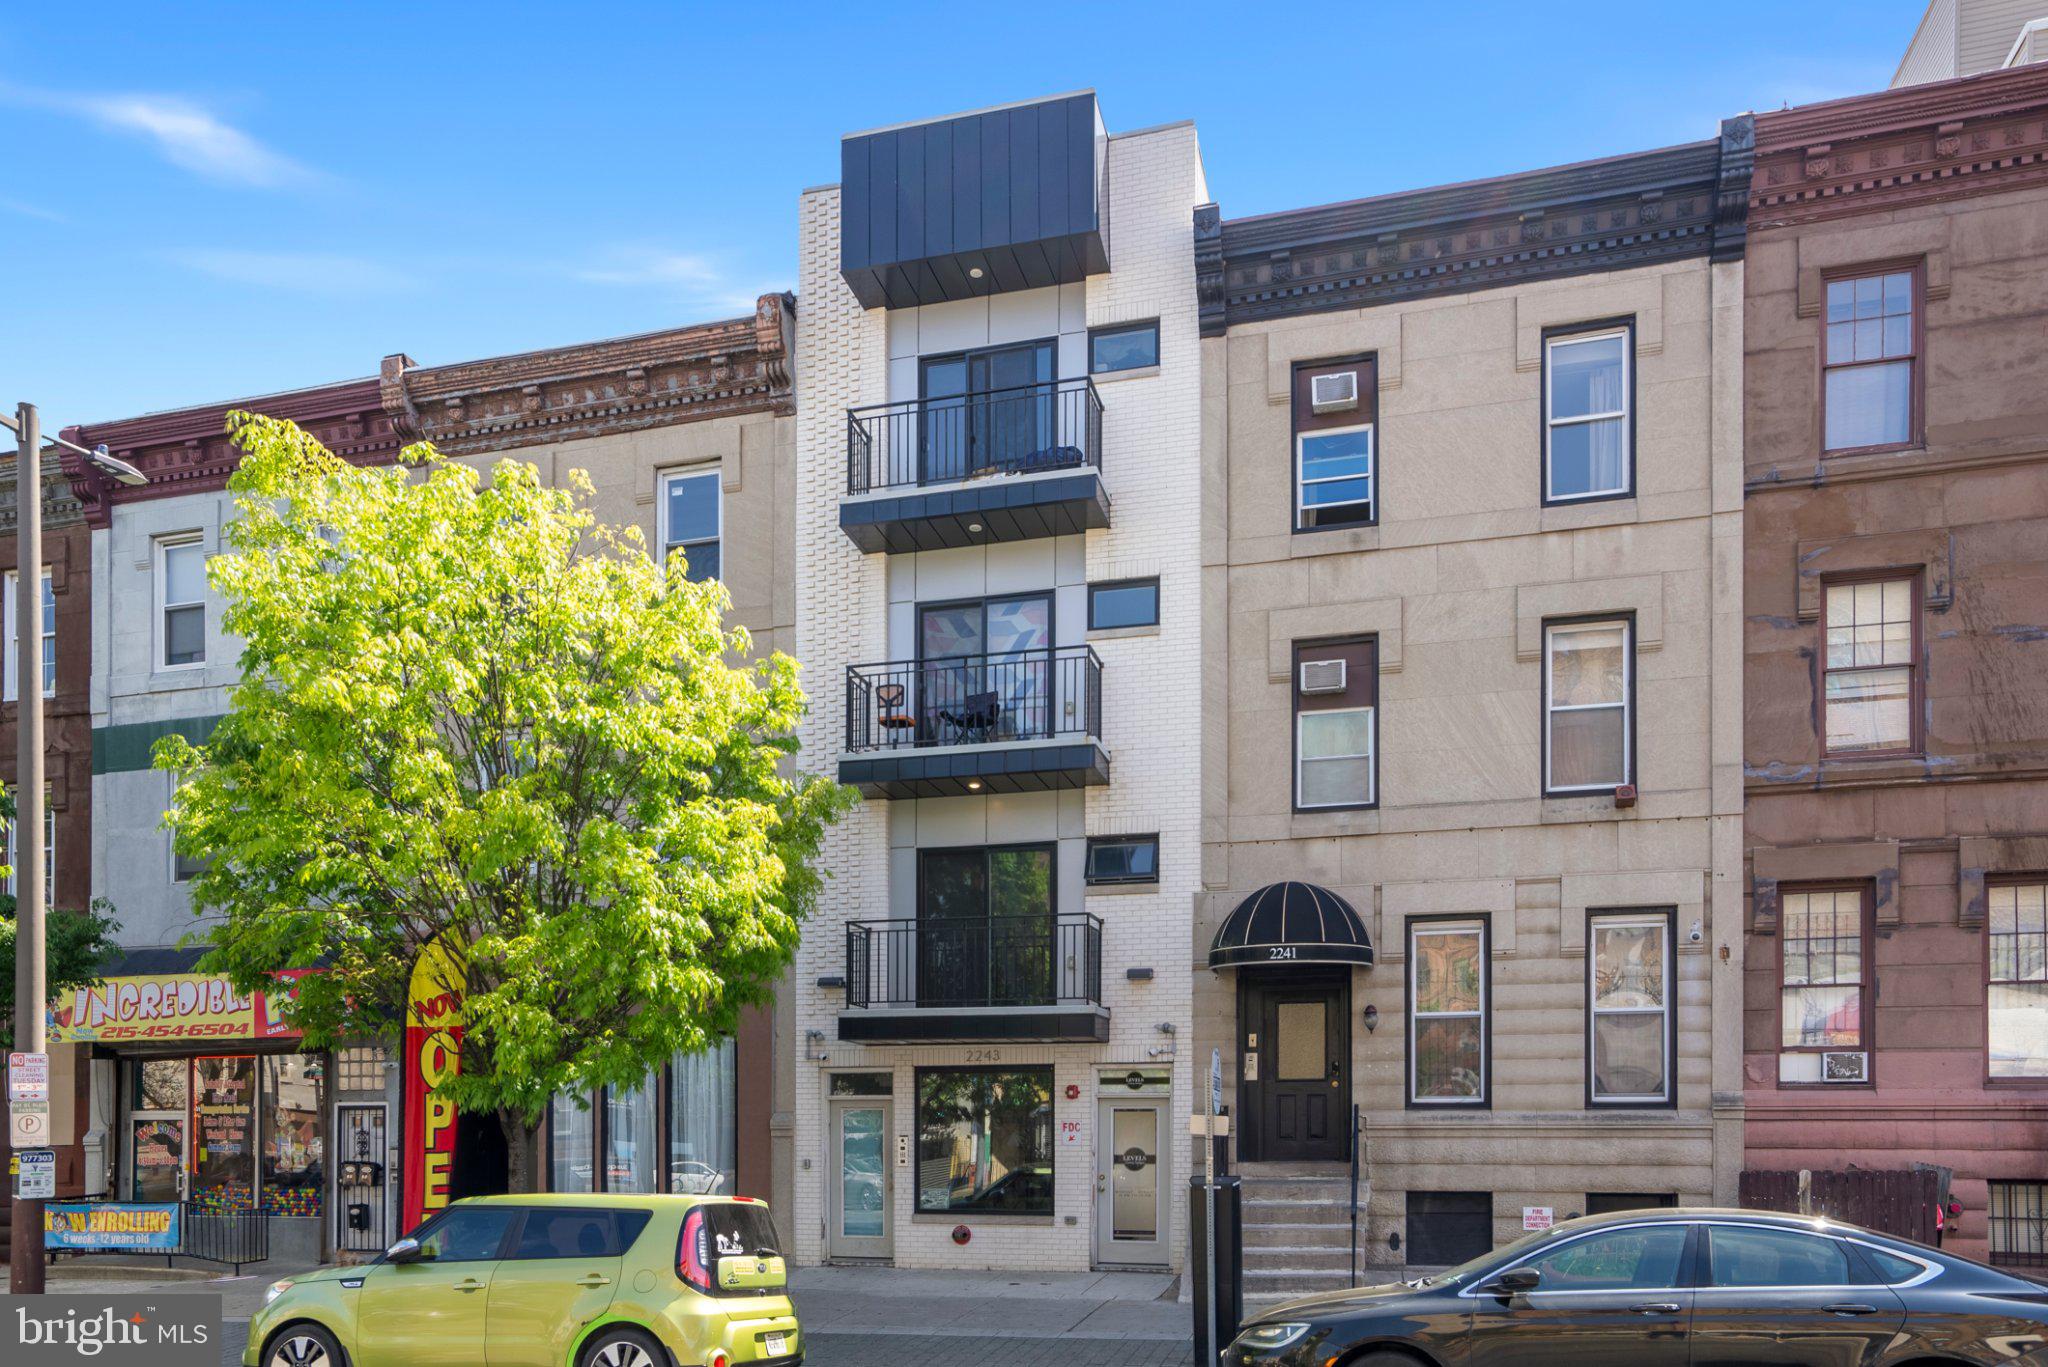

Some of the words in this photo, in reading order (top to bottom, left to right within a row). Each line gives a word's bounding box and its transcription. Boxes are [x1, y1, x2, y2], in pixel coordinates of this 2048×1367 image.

[1270, 947, 1297, 960] 2241
[74, 979, 251, 1028] INCREDIBLE
[101, 1023, 250, 1039] 215-454-6504
[12, 1055, 24, 1067] NO
[966, 1050, 1000, 1062] 2243
[135, 1121, 182, 1142] Welcome
[420, 1030, 459, 1222] OPE
[1062, 1122, 1081, 1132] FDC
[89, 1211, 171, 1233] ENROLLING
[63, 1233, 69, 1244] 6
[69, 1234, 96, 1244] weeks
[100, 1234, 108, 1244] 12
[111, 1235, 134, 1245] years
[135, 1234, 149, 1244] old
